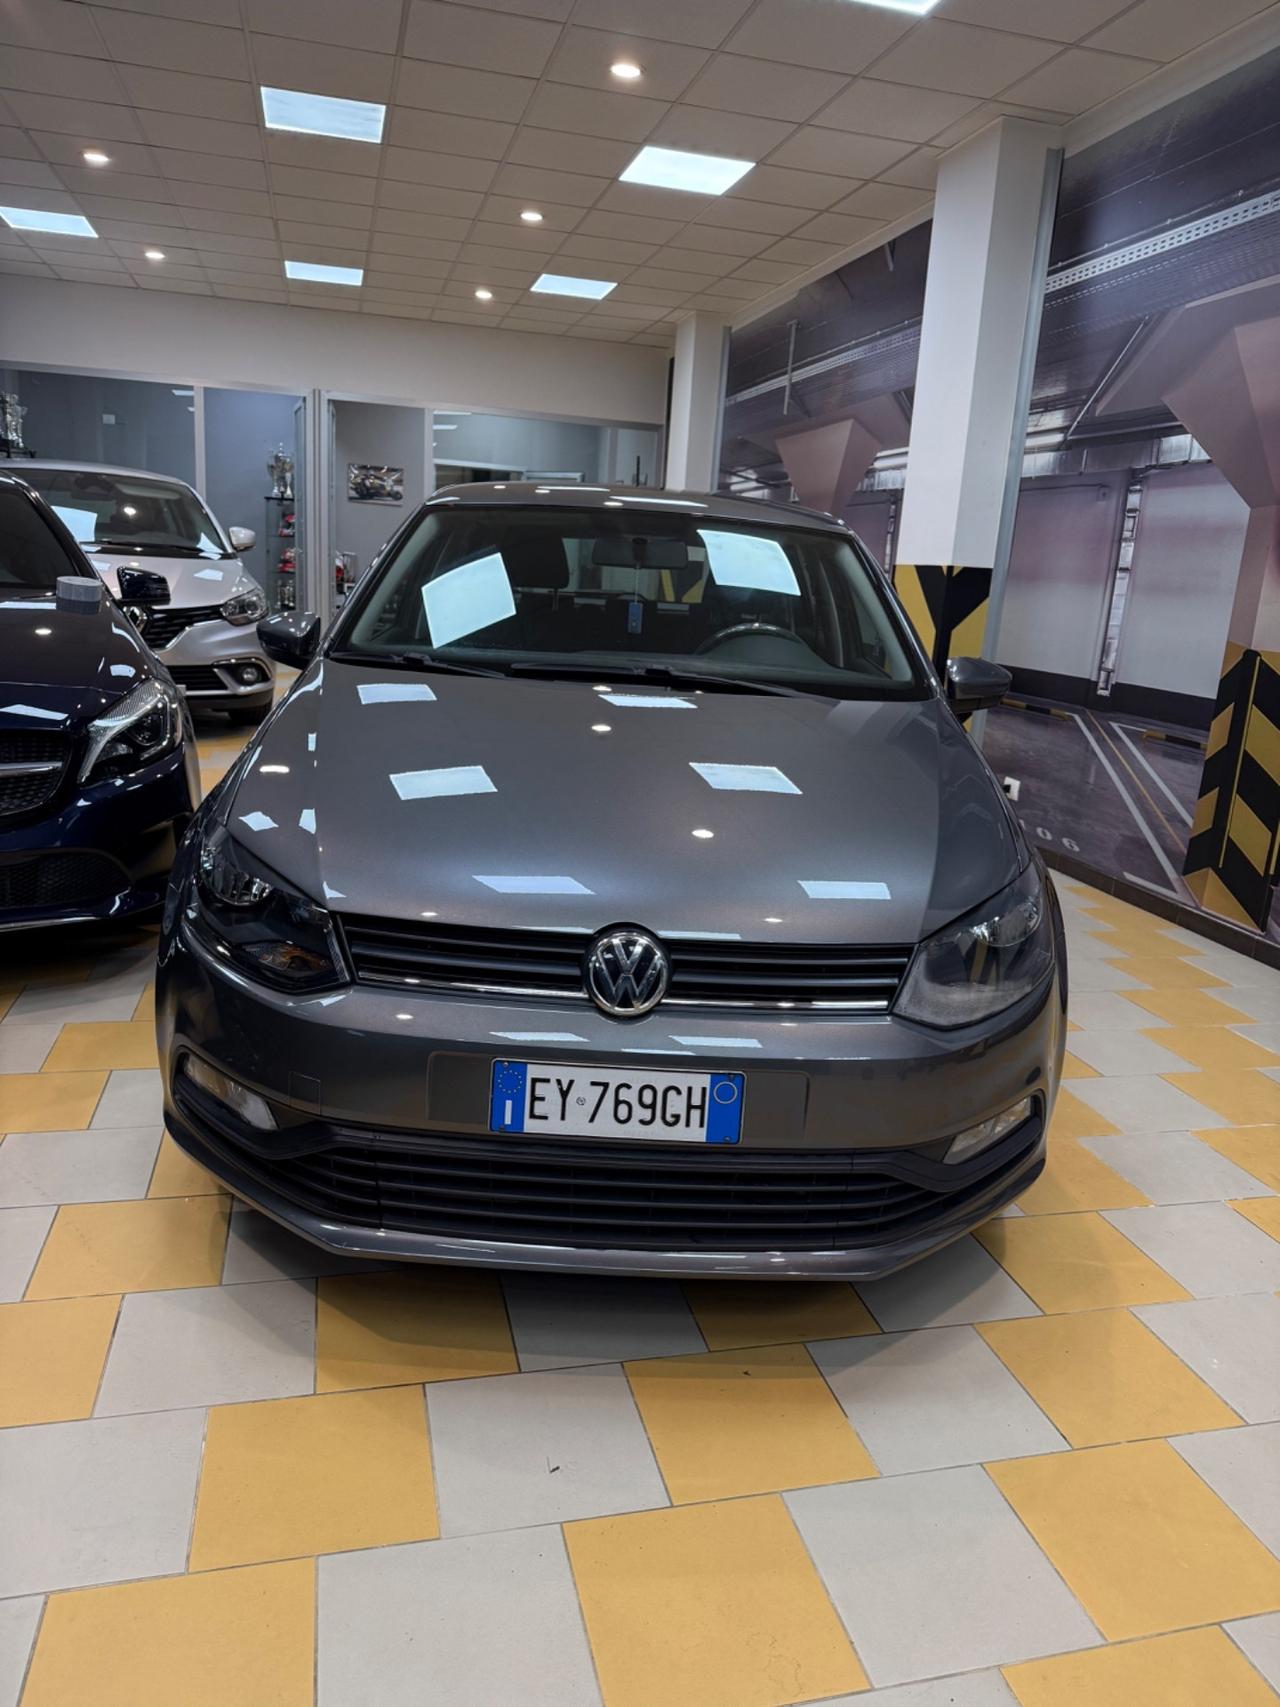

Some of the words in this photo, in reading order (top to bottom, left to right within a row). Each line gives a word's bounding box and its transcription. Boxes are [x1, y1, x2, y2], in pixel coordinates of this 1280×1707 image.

[595, 935, 662, 1005] VW
[528, 1076, 575, 1121] EY
[588, 1080, 708, 1129] 769GH
